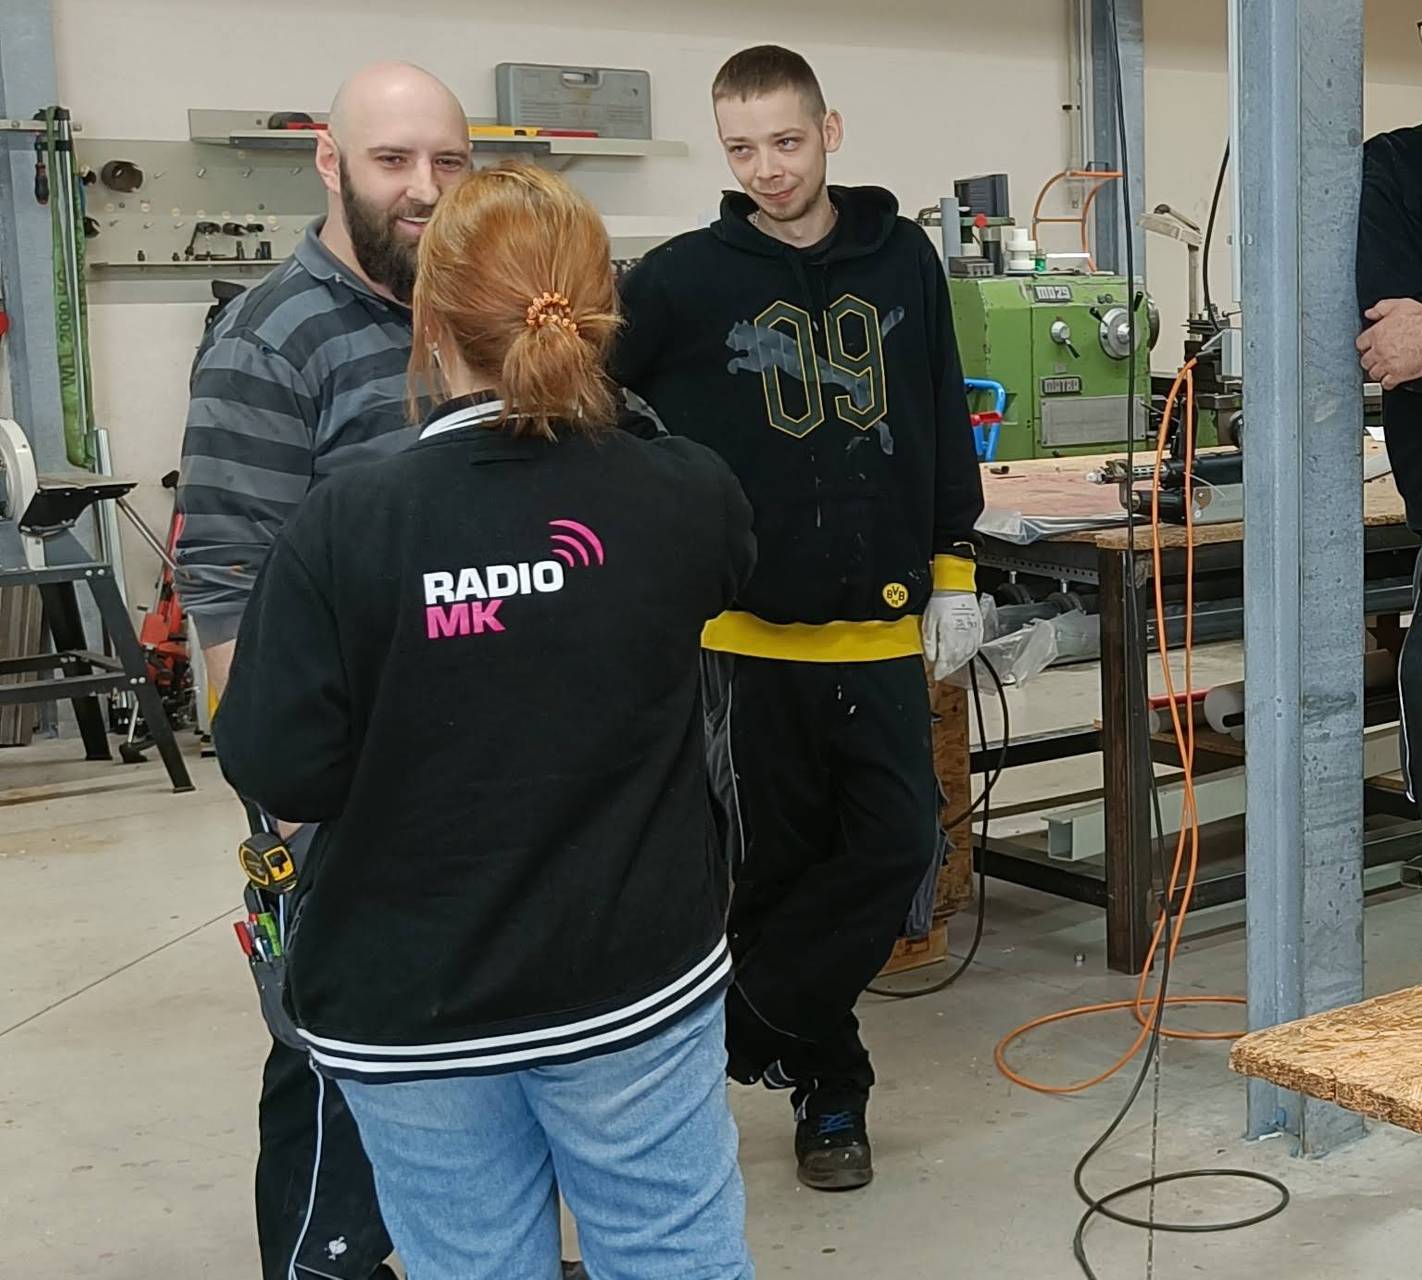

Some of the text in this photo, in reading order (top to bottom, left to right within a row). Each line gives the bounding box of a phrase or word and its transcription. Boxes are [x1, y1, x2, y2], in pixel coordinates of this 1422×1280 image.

[58, 301, 73, 343] 2000
[754, 293, 888, 438] 09
[423, 560, 565, 605] RADIO
[886, 586, 905, 601] BVB
[426, 600, 506, 639] MK
